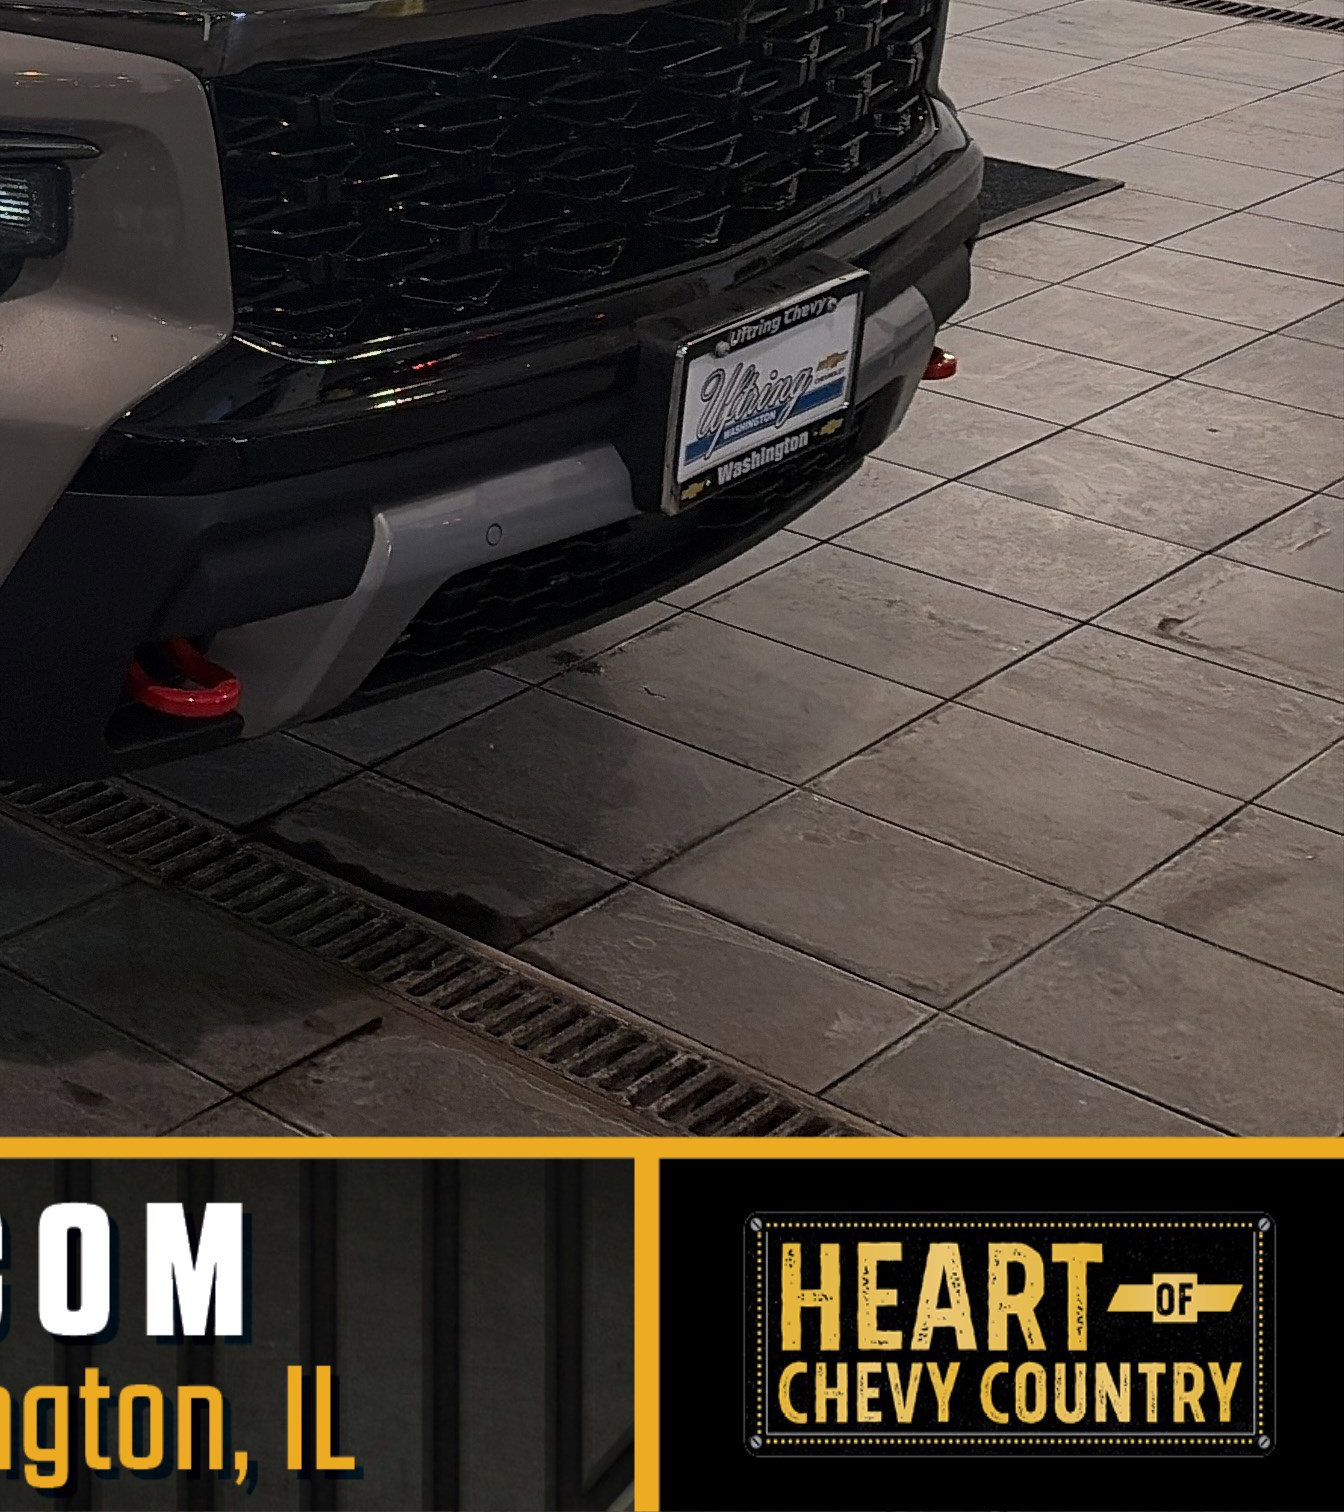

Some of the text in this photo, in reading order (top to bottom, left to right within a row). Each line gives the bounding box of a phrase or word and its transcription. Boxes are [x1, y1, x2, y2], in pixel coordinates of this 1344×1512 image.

[729, 316, 782, 346] Uftring
[697, 362, 813, 460] Uftring
[723, 410, 777, 439] WASHINGTON
[717, 431, 810, 485] Washington
